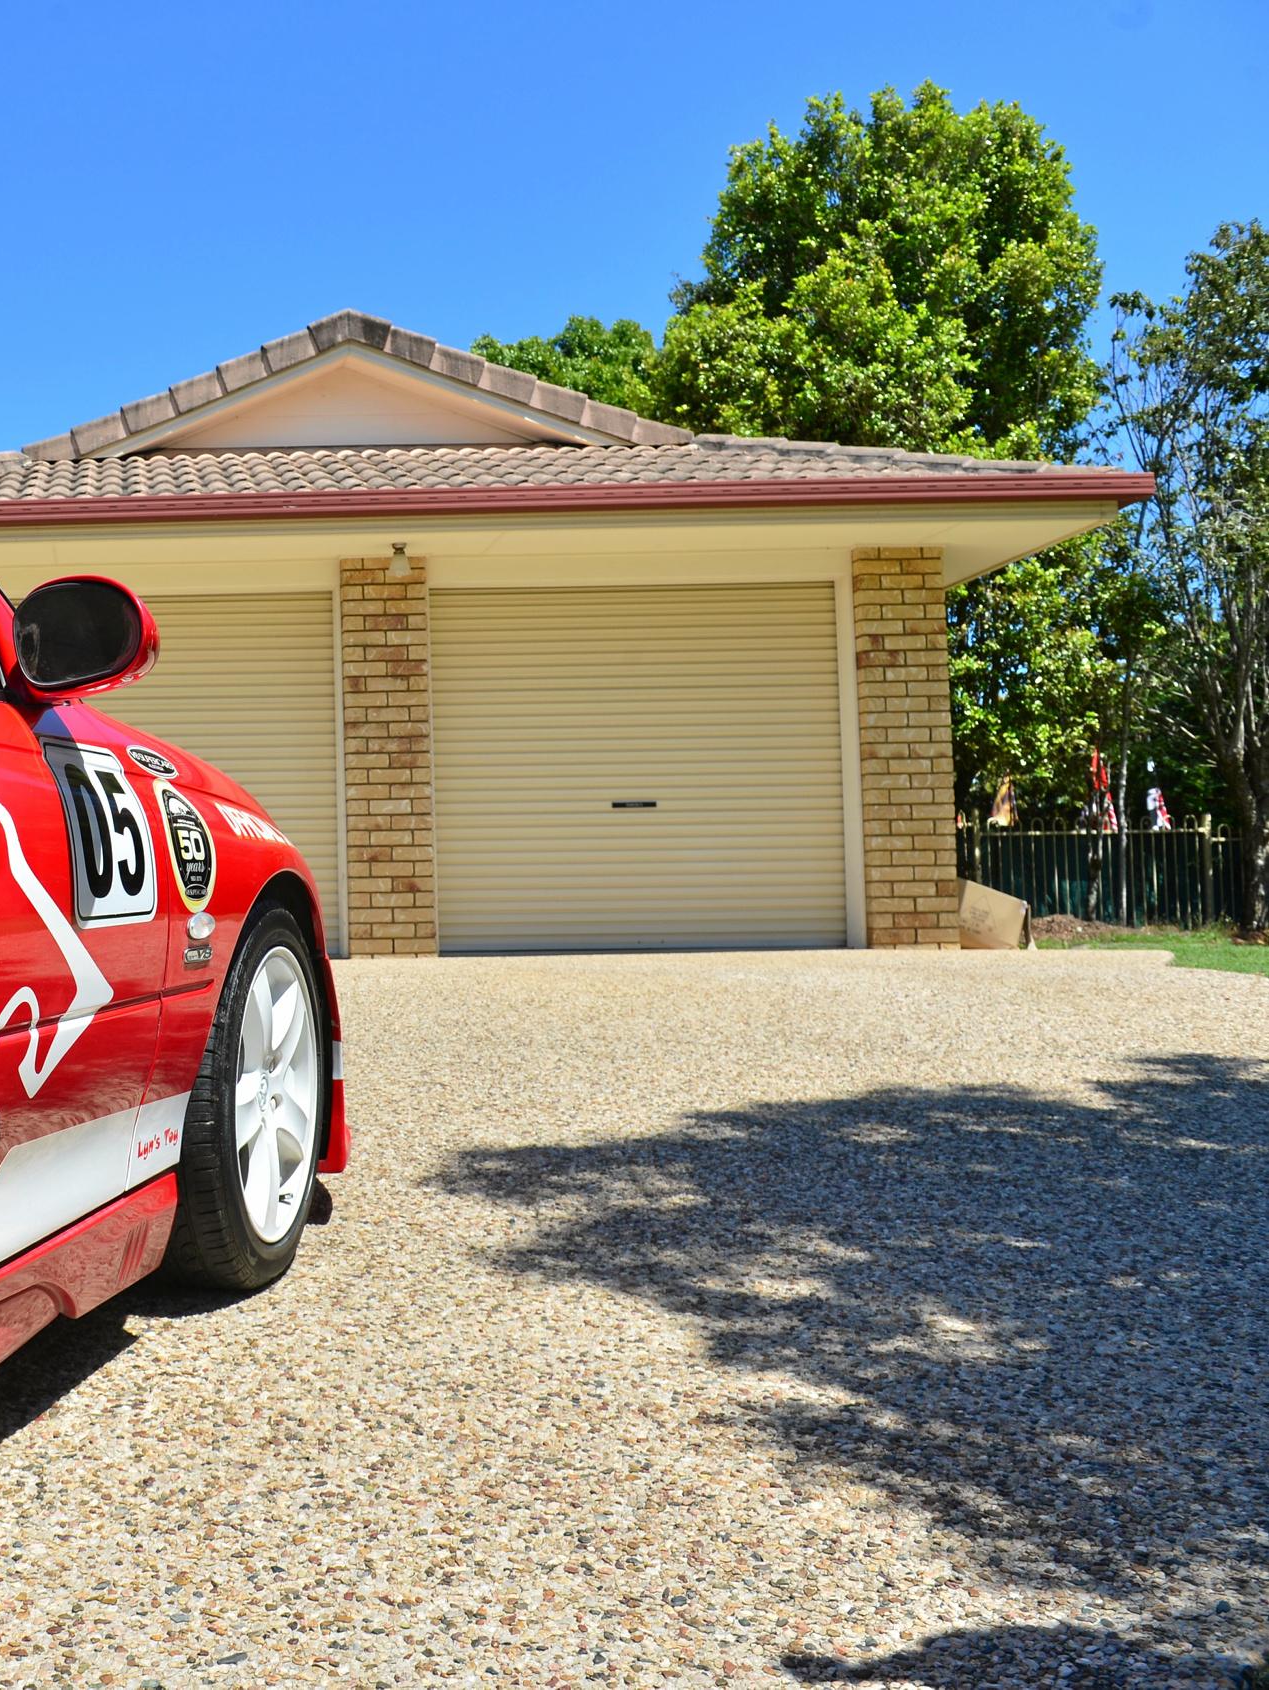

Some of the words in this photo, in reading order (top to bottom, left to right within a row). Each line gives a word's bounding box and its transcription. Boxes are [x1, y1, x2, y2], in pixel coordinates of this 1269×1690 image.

[64, 763, 145, 899] 05
[178, 829, 205, 861] 50
[185, 861, 206, 881] years
[197, 946, 212, 960] V8
[137, 1134, 161, 1160] Lyn's
